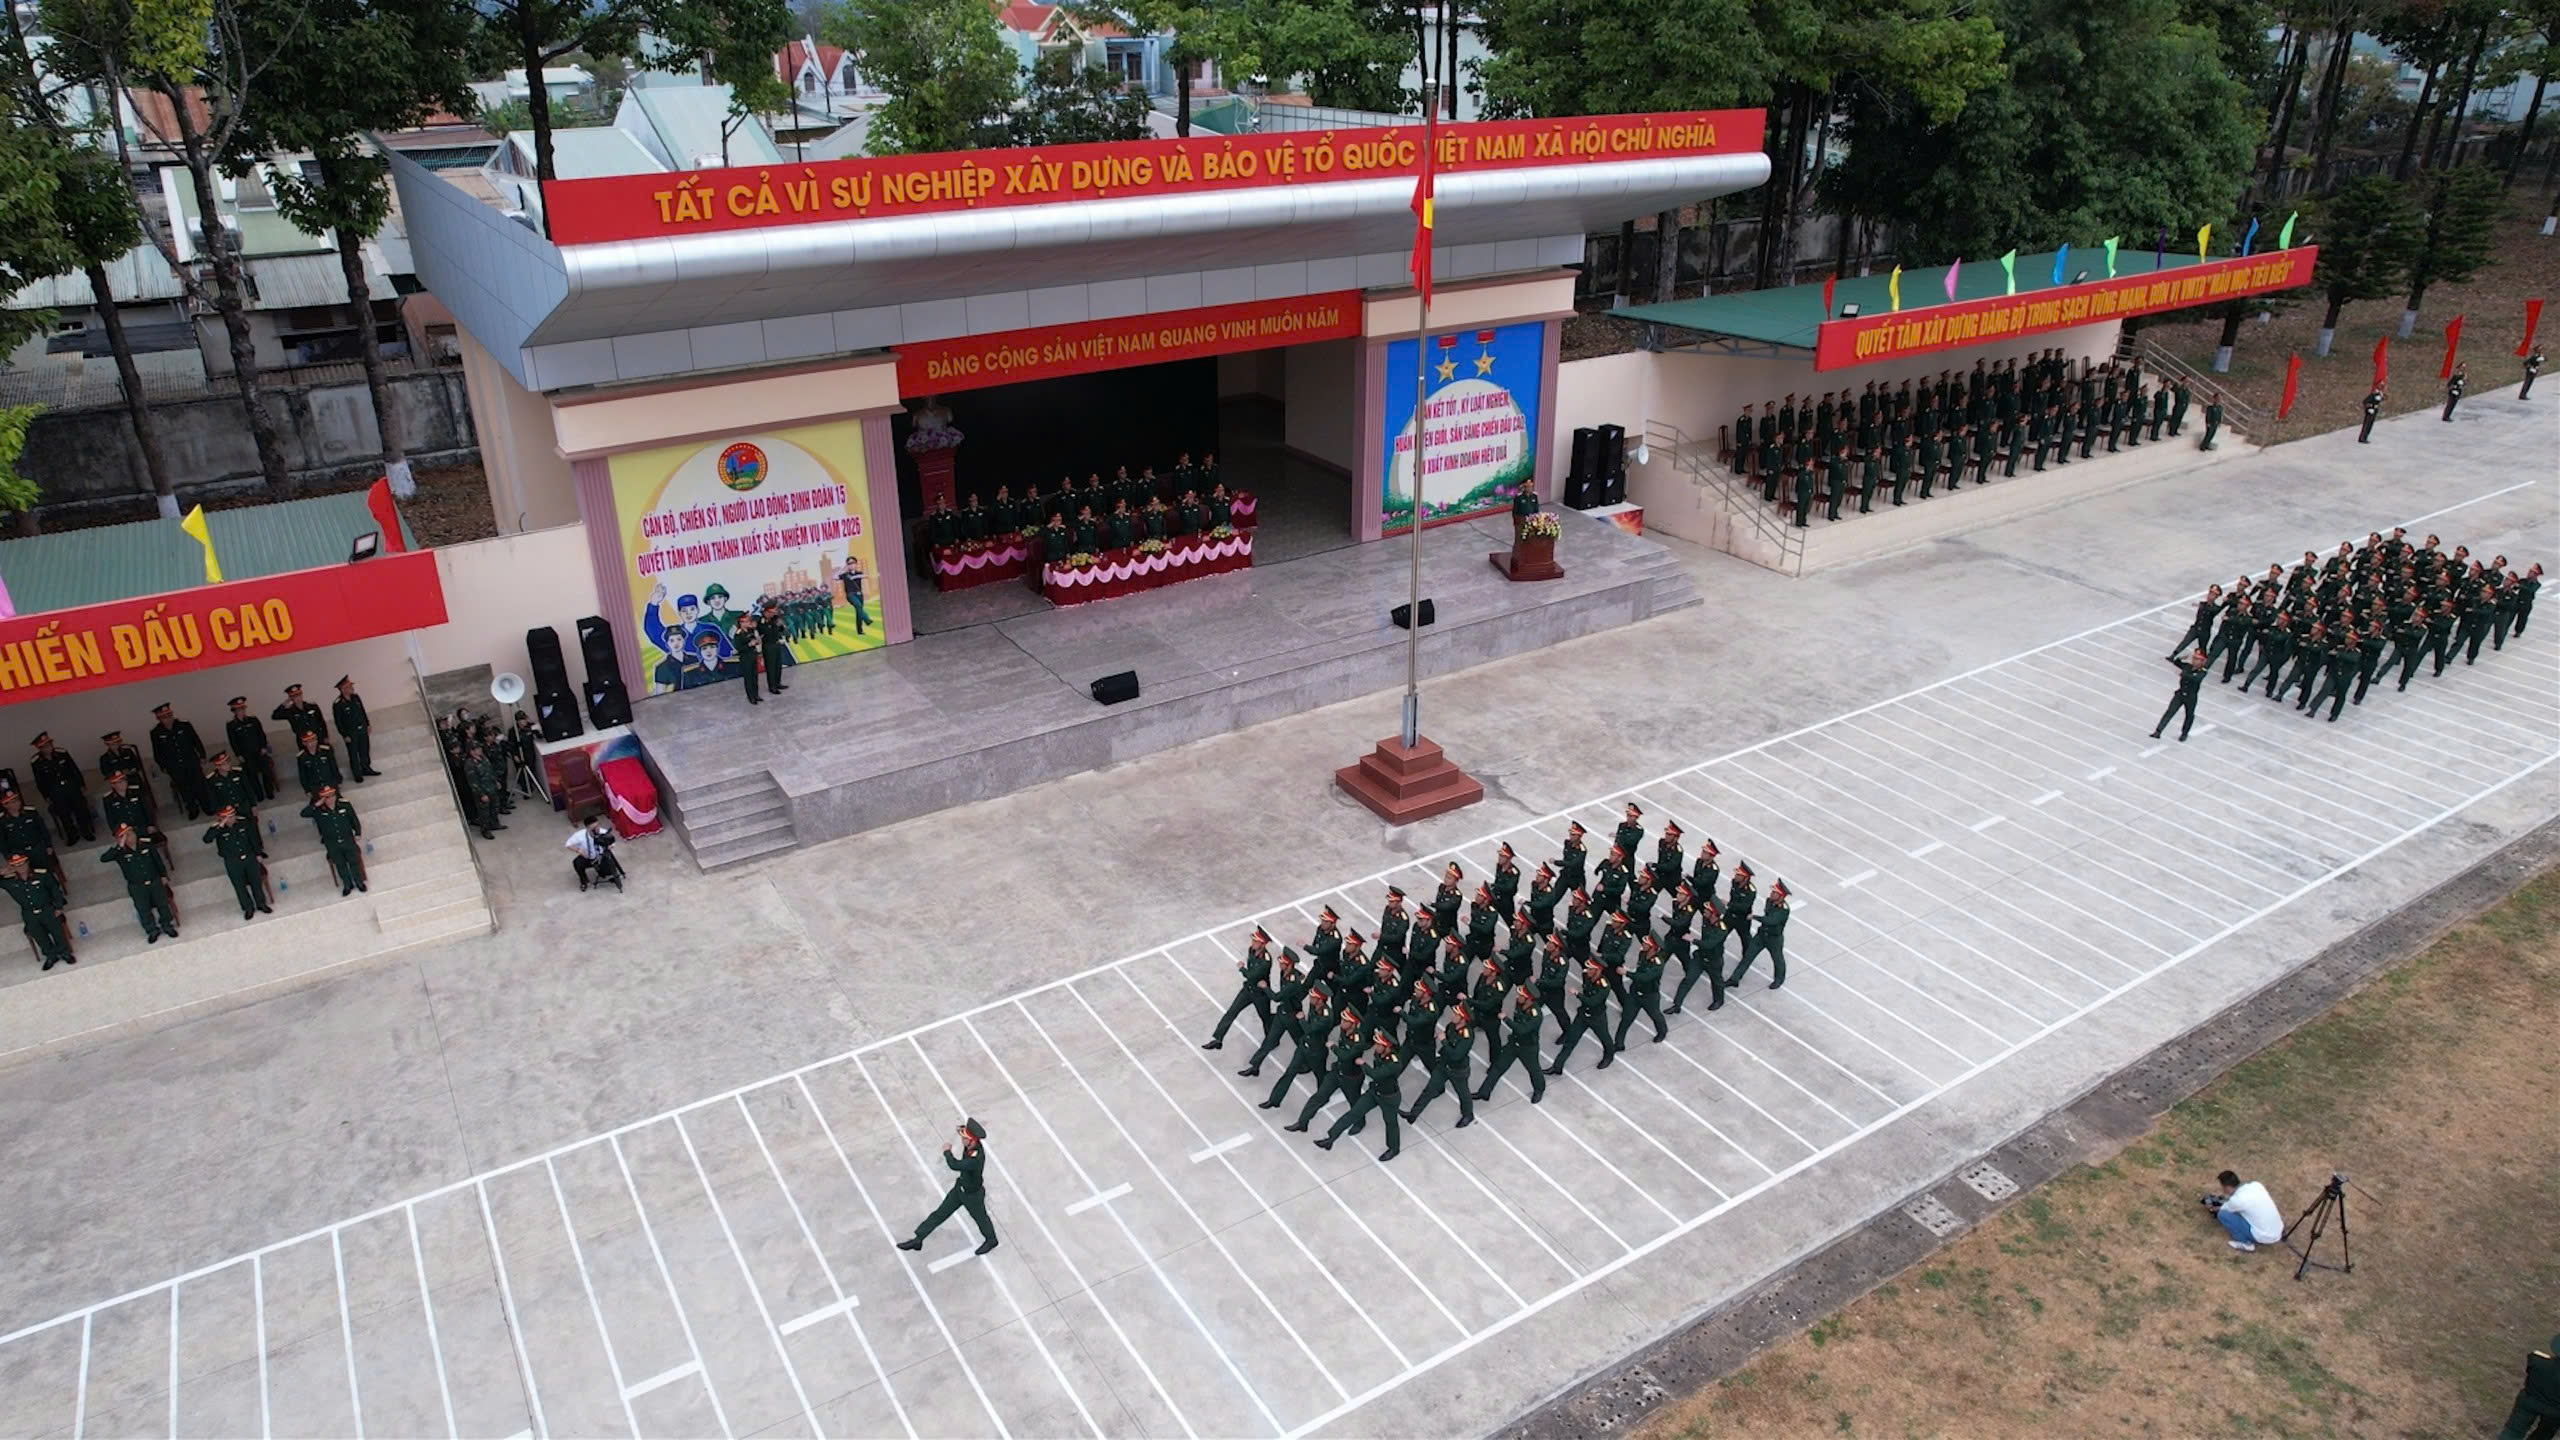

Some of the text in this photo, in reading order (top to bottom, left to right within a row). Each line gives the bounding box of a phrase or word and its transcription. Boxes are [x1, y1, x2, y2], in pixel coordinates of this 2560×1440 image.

[654, 174, 715, 223] TẤT
[727, 170, 781, 217] CẢ
[784, 167, 820, 212] VÌ
[831, 171, 872, 215] SỰ
[881, 160, 996, 206] NGHIỆP
[1004, 154, 1063, 194] XÂY
[1072, 154, 1153, 196] DỰNG
[1159, 144, 1194, 182] VÀ
[1203, 140, 1257, 180] BẢO
[1264, 139, 1296, 182] VỆ
[1302, 131, 1335, 173] TỔ
[1343, 128, 1416, 171] QUỐC
[1476, 134, 1525, 161] NAM
[1533, 125, 1564, 157] XÃ
[1570, 122, 1607, 161] HỘI
[1611, 118, 1651, 151] CHỦ
[1657, 118, 1717, 149] NGHĨA
[928, 306, 1339, 380] ĐẢNG CỘNG SẢN VIỆT NAM QUANG VINH MUÔN NĂM
[1855, 318, 1895, 359] QUYẾT
[1895, 319, 1923, 350] TÂM
[1922, 314, 1946, 345] XÂY
[1945, 312, 1979, 345] DỰNG
[1979, 303, 2011, 335] ĐẢNG
[2010, 301, 2028, 334] BỘ
[2026, 299, 2061, 328] TRONG
[679, 503, 706, 531] CHIẾN
[749, 498, 766, 520] LAO
[766, 492, 789, 520] ĐỘNG
[811, 483, 834, 509] ĐOÀN
[835, 485, 846, 505] 15
[638, 517, 862, 576] QUYẾT TÂM HOÀN THÀNH XUẤT SẮC NHIỆM VỤ NĂM 2026
[111, 602, 203, 670] ĐẤU
[208, 598, 294, 651] CAO
